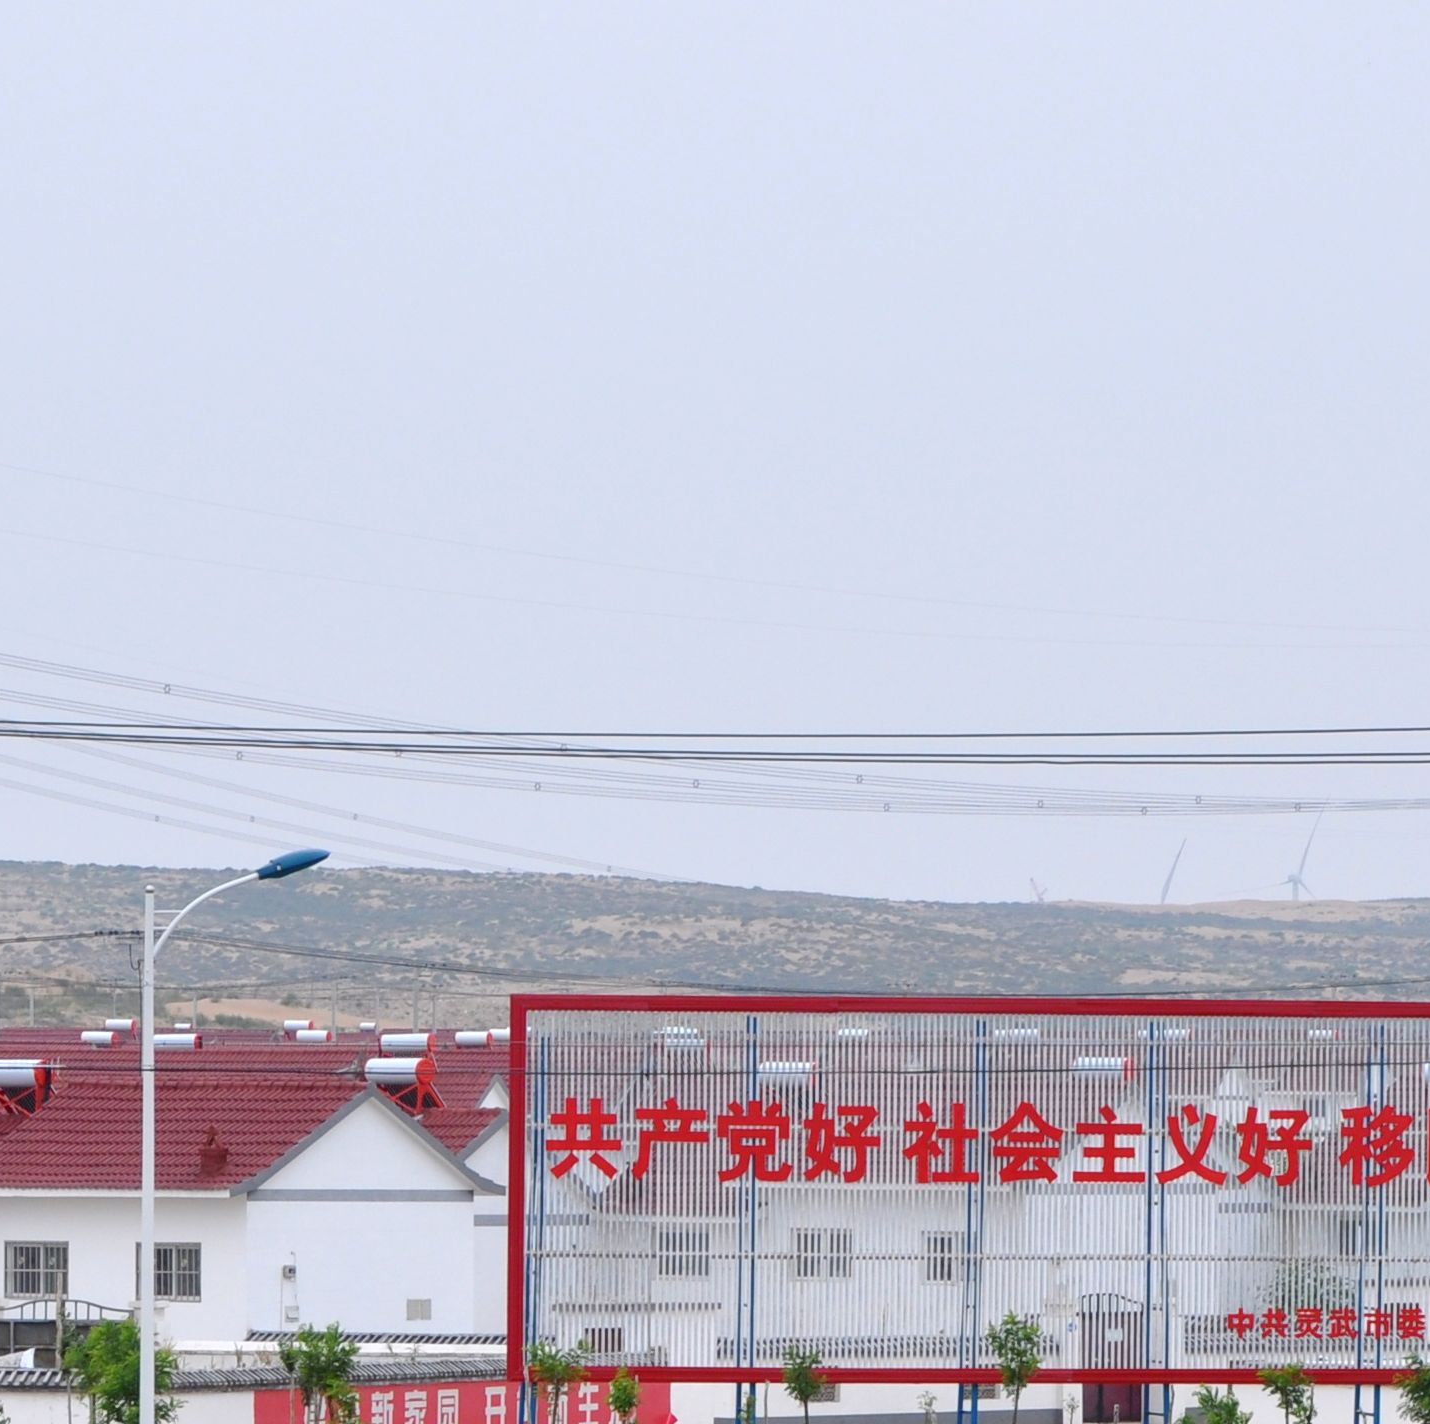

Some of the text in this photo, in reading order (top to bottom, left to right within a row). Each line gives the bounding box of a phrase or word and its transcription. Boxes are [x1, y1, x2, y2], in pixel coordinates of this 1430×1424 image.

[545, 1097, 881, 1183] 共产党好
[902, 1100, 1313, 1187] 社会主义好
